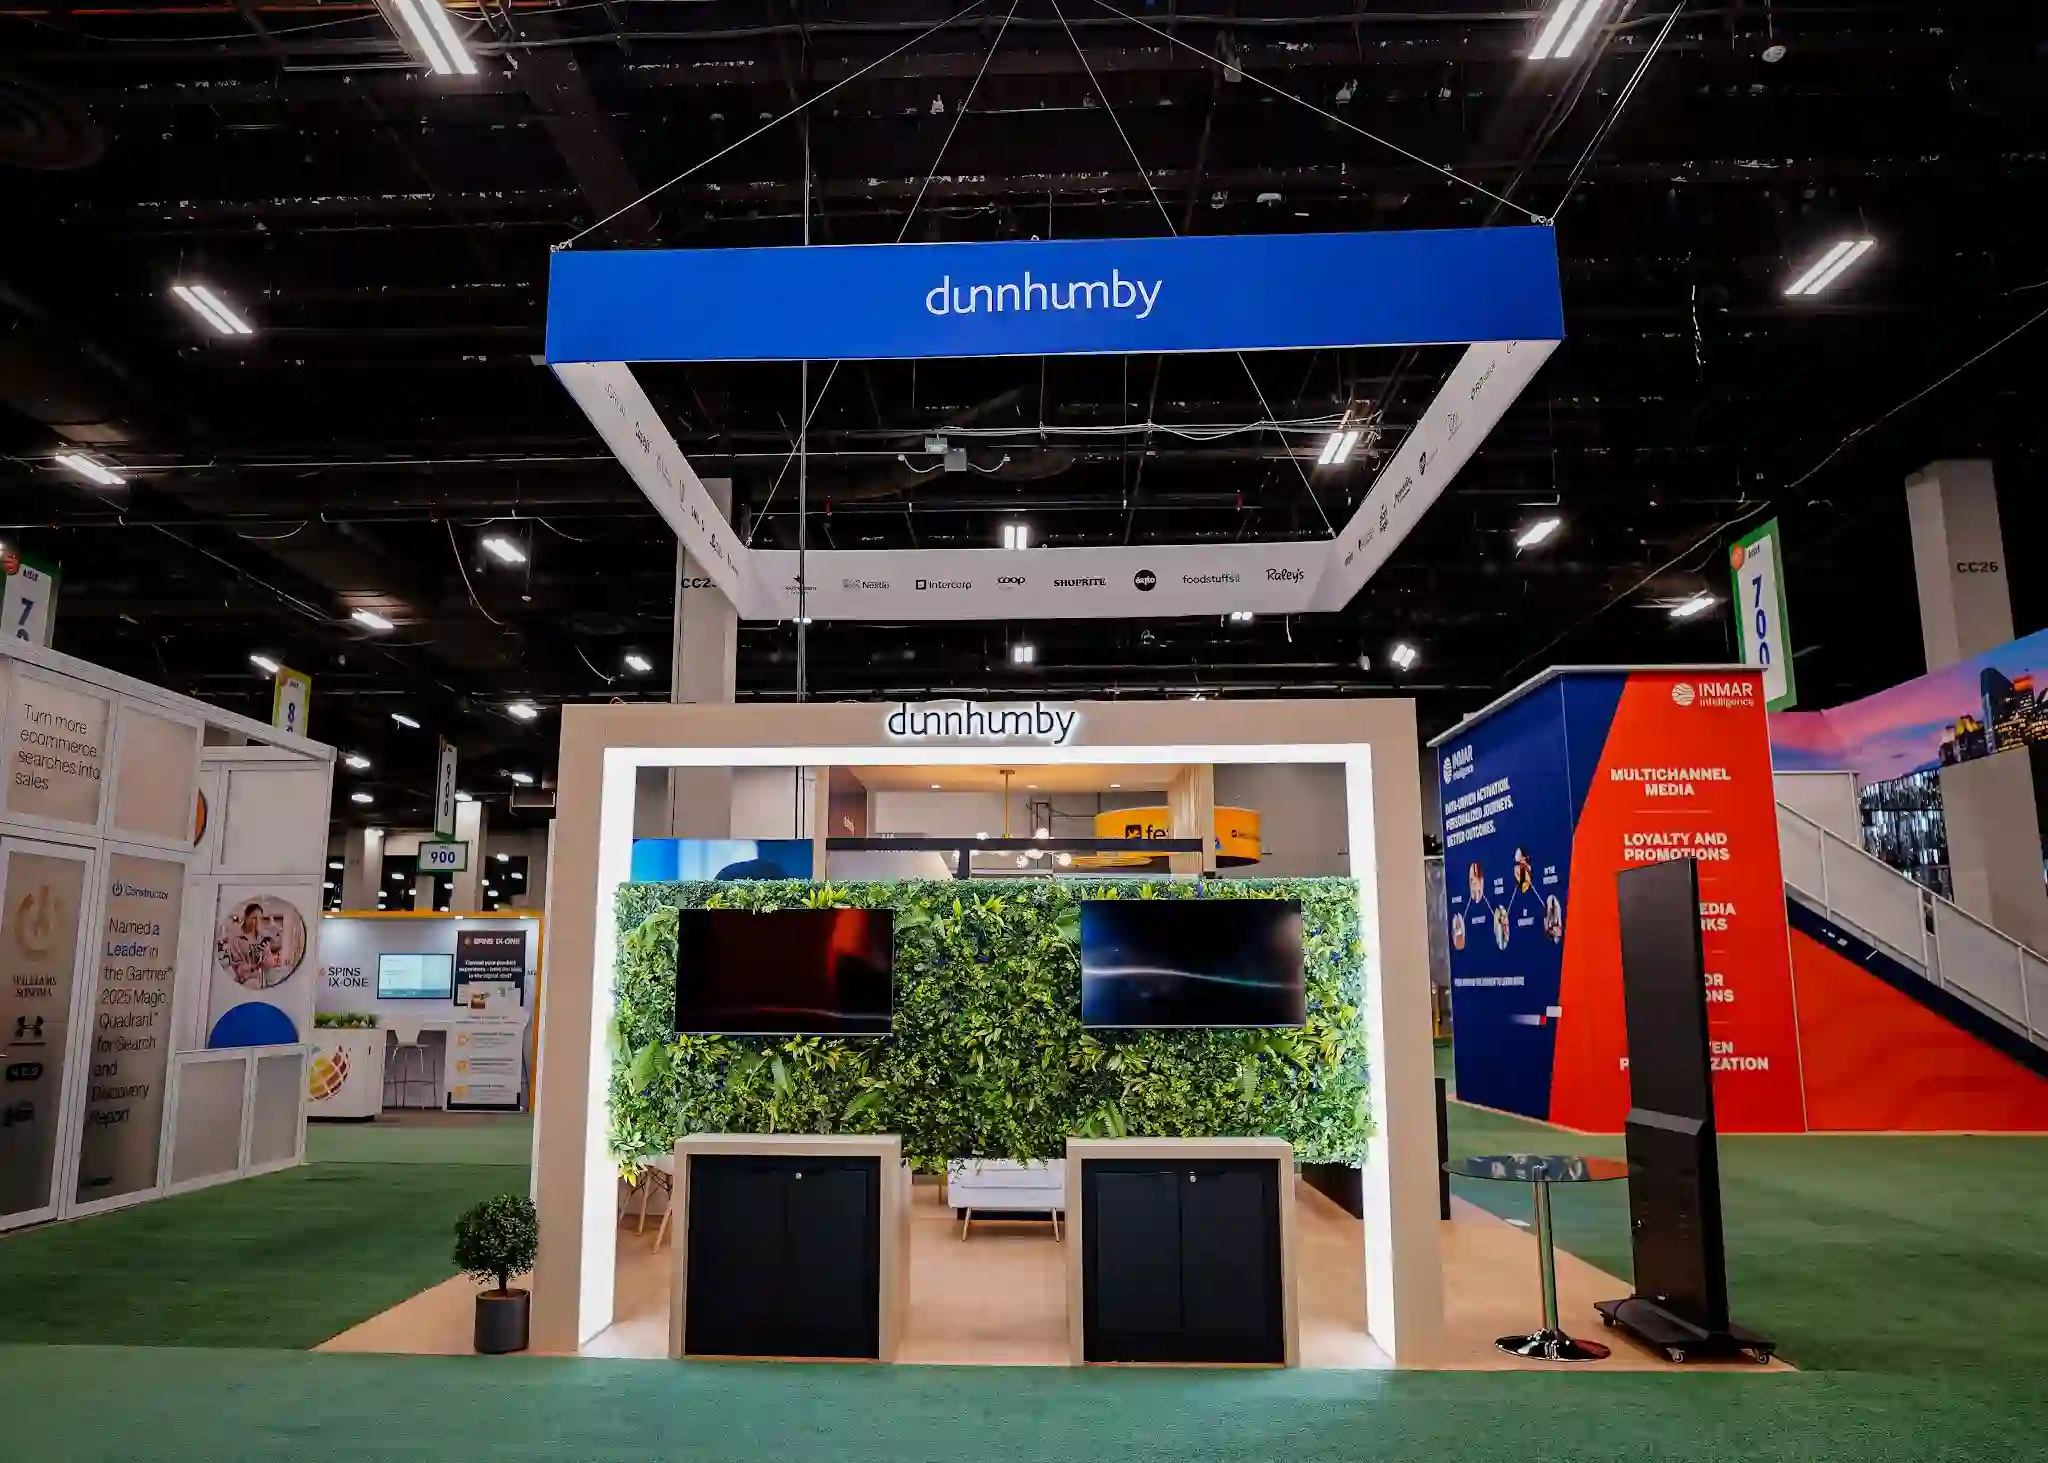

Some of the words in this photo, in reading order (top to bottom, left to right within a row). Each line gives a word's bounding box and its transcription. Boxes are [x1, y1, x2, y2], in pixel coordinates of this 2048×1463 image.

[925, 268, 1163, 320] dunnhumby
[1265, 567, 1304, 583] Raley's
[1956, 561, 1999, 574] CC26
[681, 577, 717, 589] CC2
[928, 579, 972, 590] Intercorp
[997, 576, 1026, 586] coop
[1698, 682, 1753, 697] INMAR
[24, 703, 53, 728] Turn
[55, 715, 88, 736] more
[887, 702, 1076, 745] dunnhumby
[19, 728, 98, 758] ecommerce
[18, 749, 78, 775] searches
[78, 760, 101, 780] into
[14, 770, 50, 790] sales
[1610, 768, 1731, 782] MULTICHANNEL
[1645, 783, 1695, 797] MEDIA
[1623, 832, 1691, 846] LOYALTY
[1694, 832, 1728, 845] AND
[430, 851, 456, 863] 900
[1624, 847, 1731, 861] PROMOTIONS
[1699, 902, 1736, 916] EDIA
[109, 917, 151, 936] Named
[152, 925, 160, 936] a
[107, 941, 147, 957] Leader
[104, 965, 124, 980] the
[328, 967, 361, 977] SPINS
[328, 977, 370, 988] IX-ONE
[101, 988, 132, 1005] 2025
[133, 988, 167, 1007] Magic
[115, 1036, 156, 1053] Search
[93, 1060, 118, 1077] and
